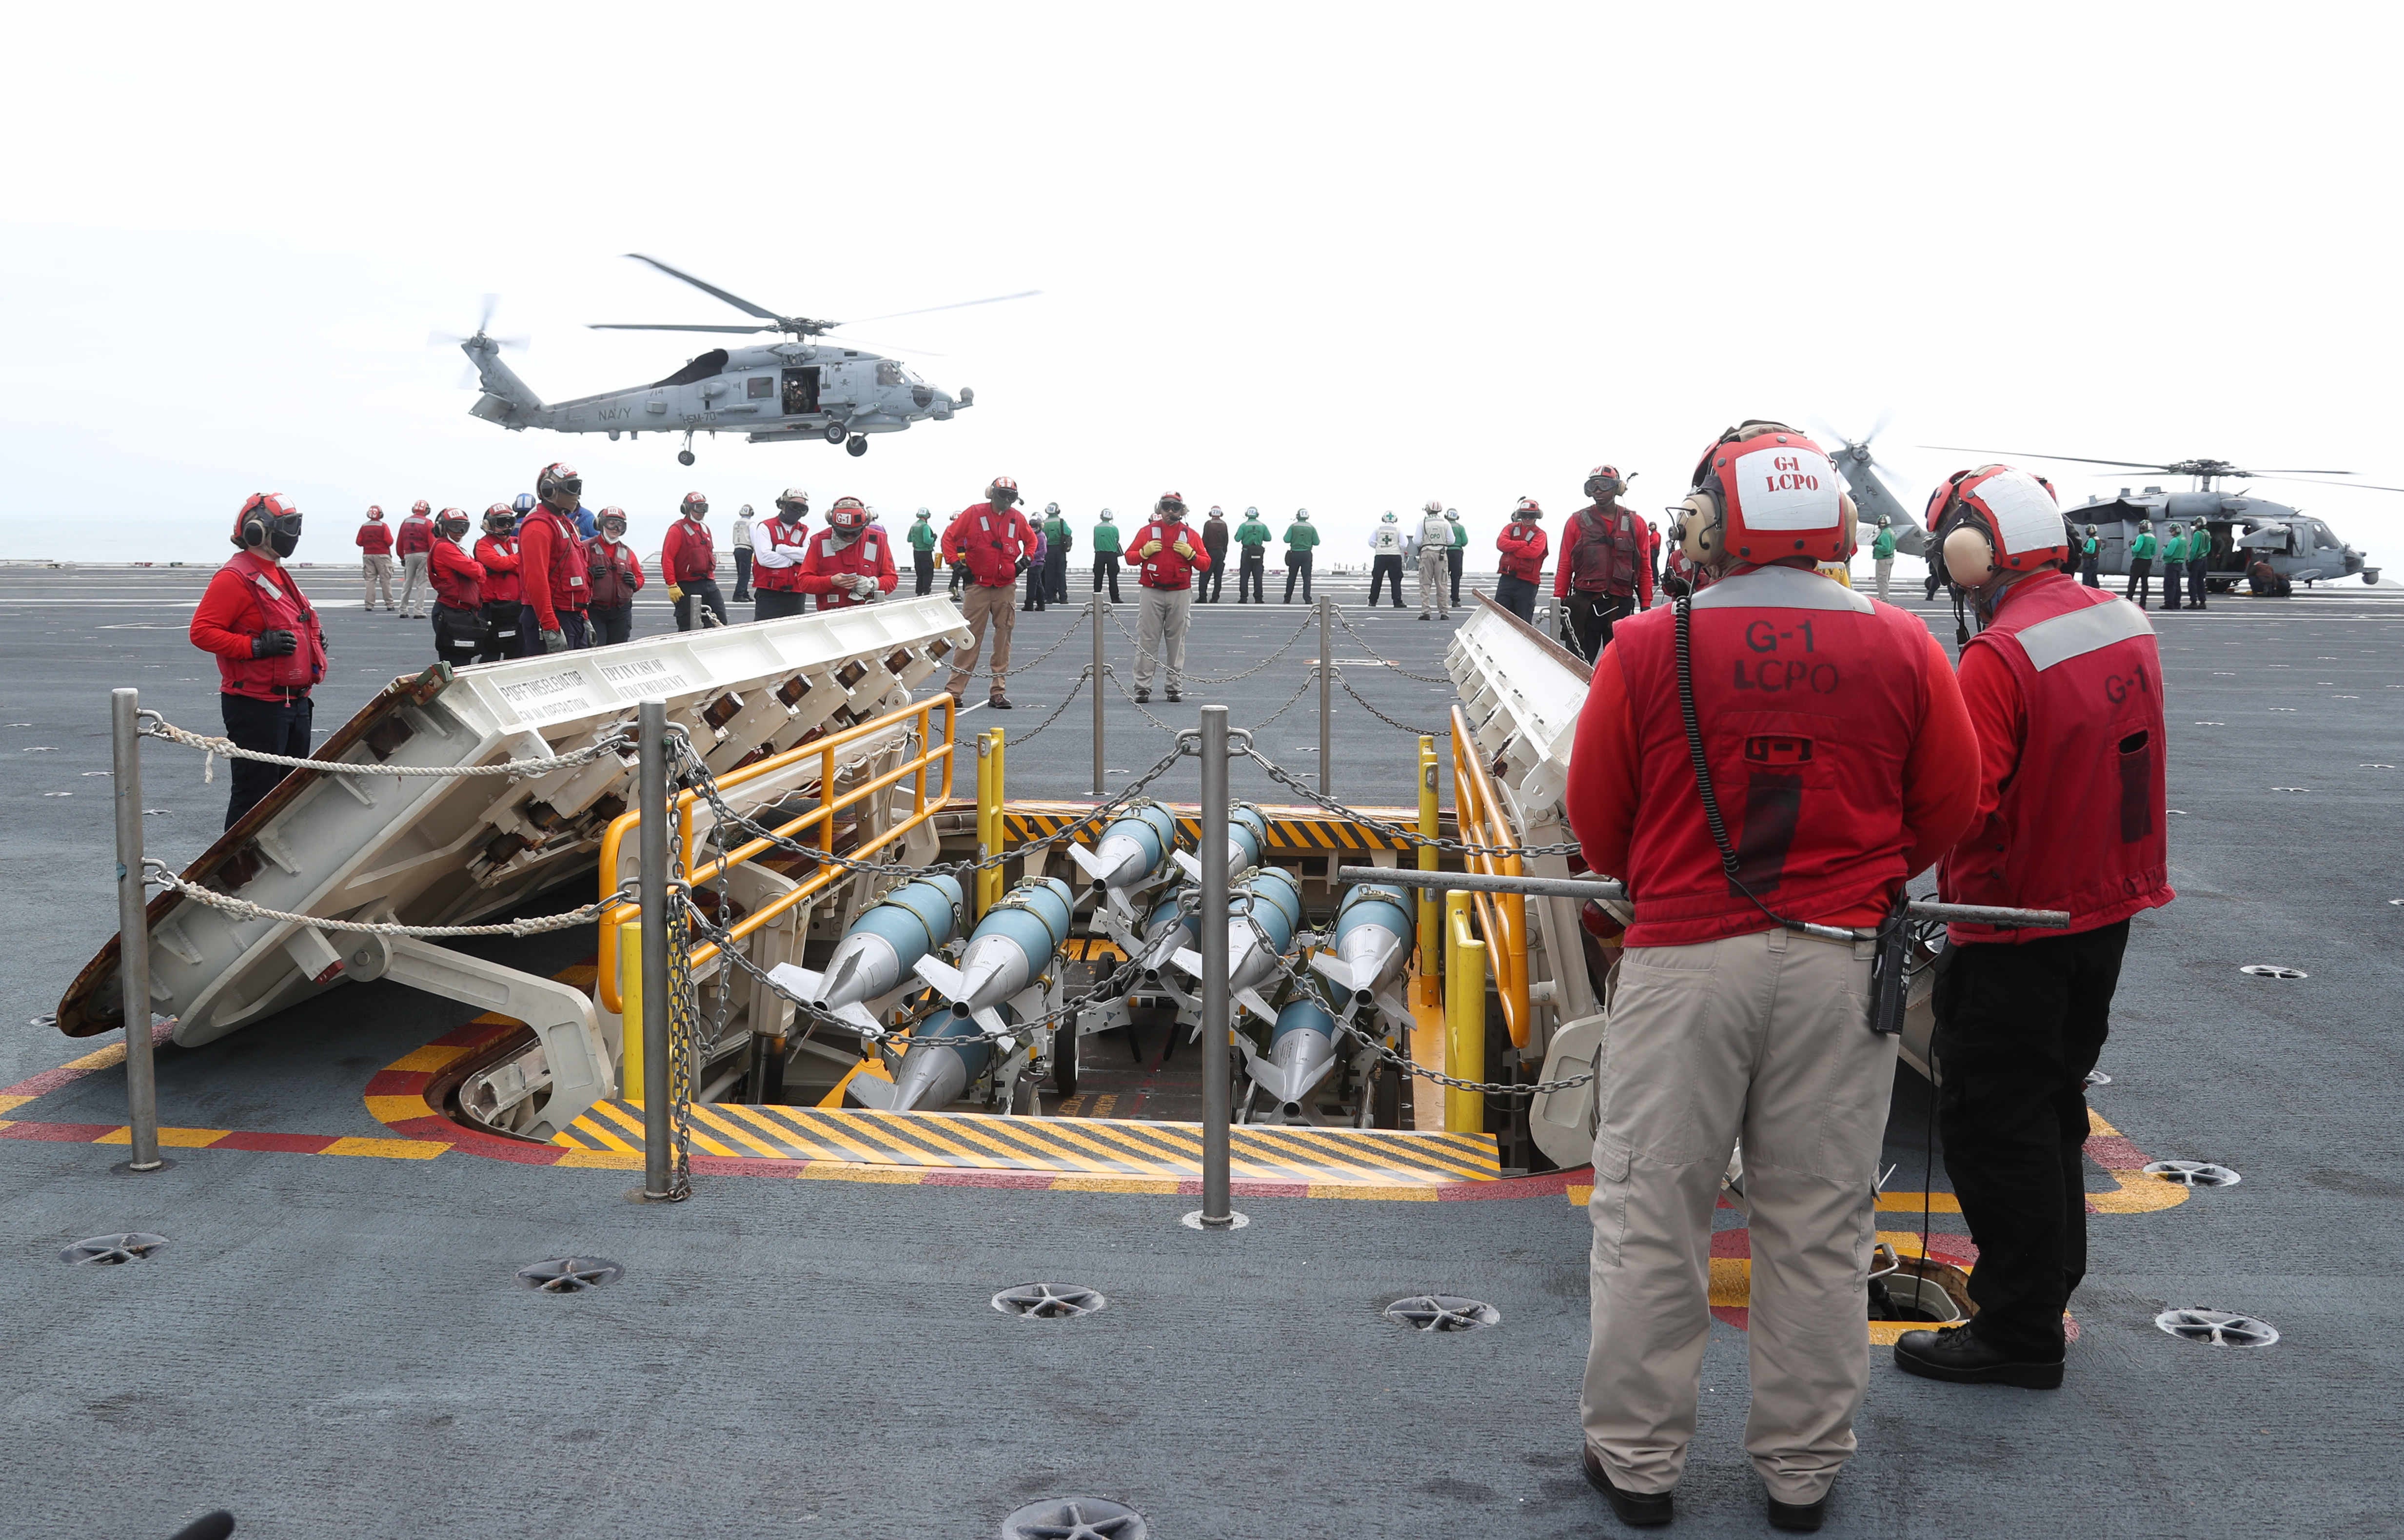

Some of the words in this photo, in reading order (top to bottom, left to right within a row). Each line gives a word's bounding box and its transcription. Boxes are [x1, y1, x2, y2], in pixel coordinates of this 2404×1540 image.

[598, 407, 631, 421] NAVY
[683, 412, 717, 425] HSM-70
[1773, 456, 1800, 471] G-1
[1766, 474, 1818, 492] LCPO
[837, 513, 849, 524] G-1
[1746, 620, 1814, 652] G-1
[630, 660, 658, 677] CASE
[1733, 660, 1839, 694] LCPO
[2105, 664, 2147, 704] G-1
[1745, 736, 1813, 762] G-1
